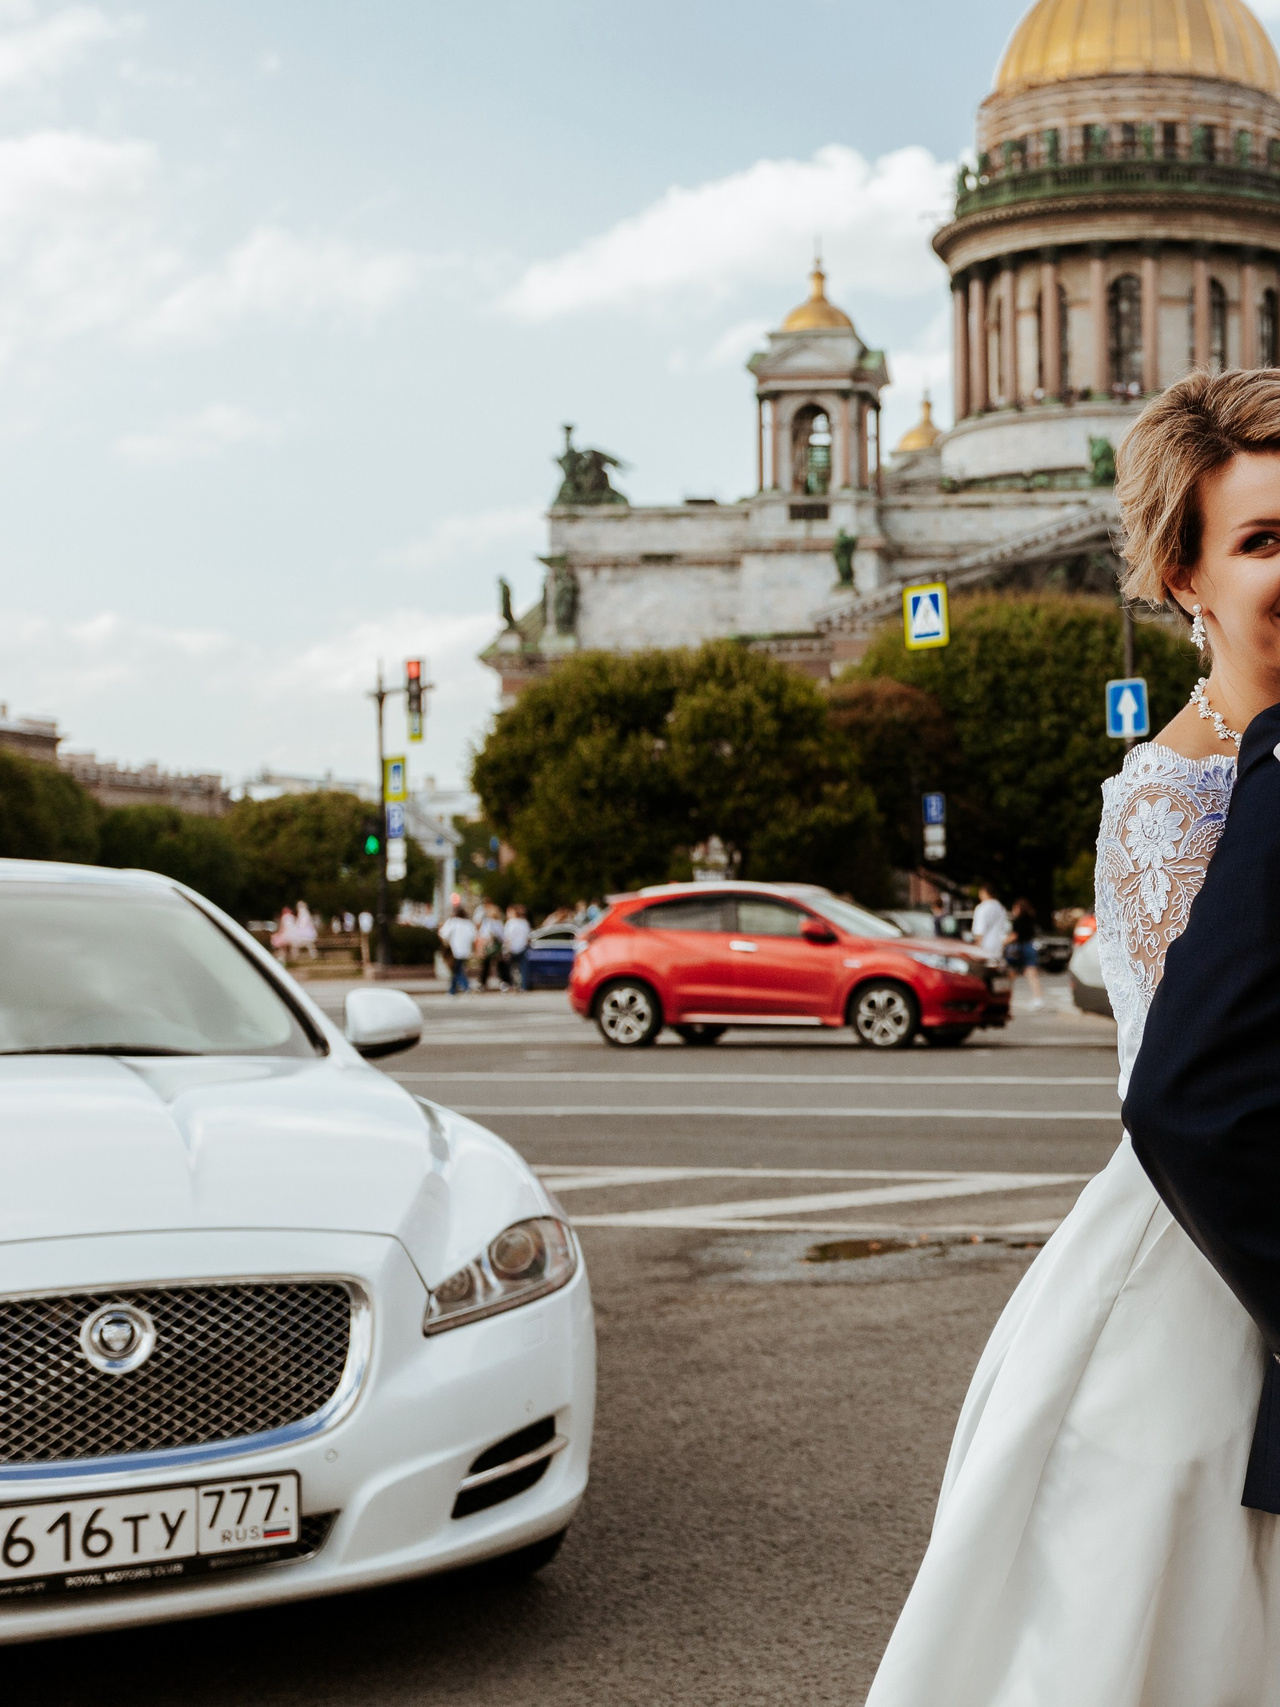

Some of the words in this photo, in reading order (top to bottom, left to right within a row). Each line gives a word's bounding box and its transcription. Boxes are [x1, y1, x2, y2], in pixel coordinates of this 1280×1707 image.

[203, 1483, 281, 1529] 777
[221, 1524, 261, 1544] RUS
[65, 1574, 103, 1589] ROYAL
[104, 1567, 152, 1583] MOTORS
